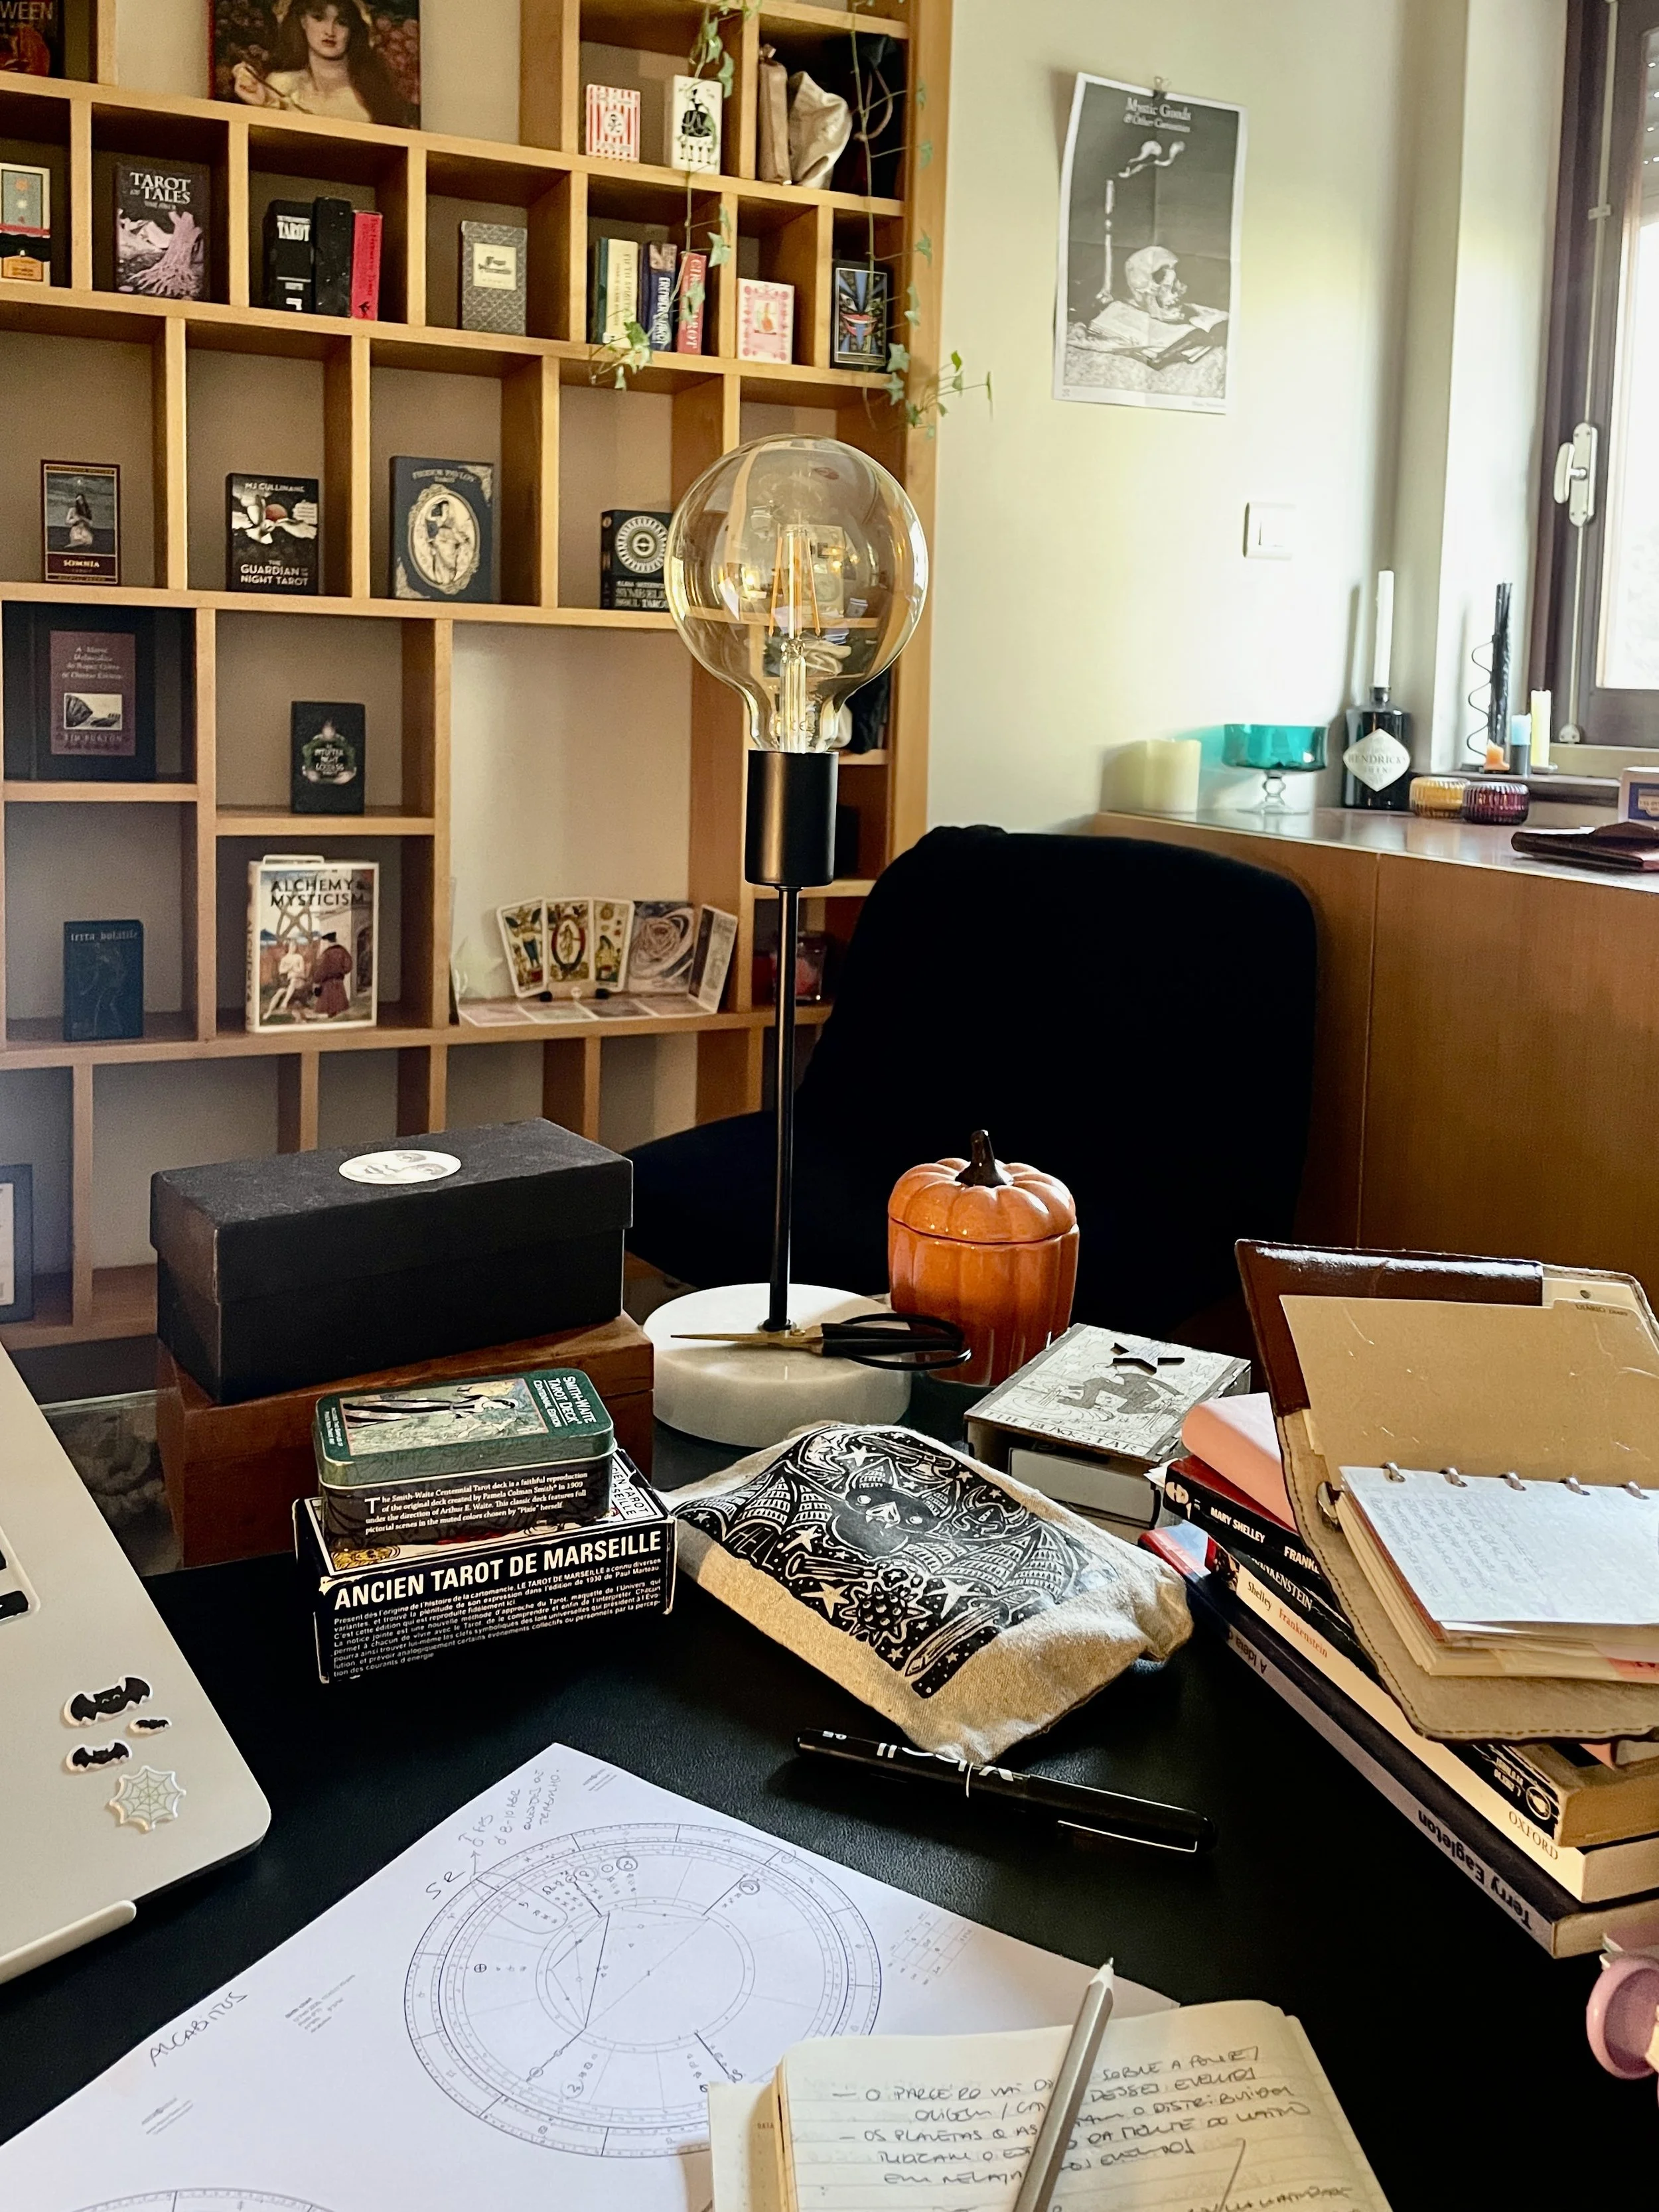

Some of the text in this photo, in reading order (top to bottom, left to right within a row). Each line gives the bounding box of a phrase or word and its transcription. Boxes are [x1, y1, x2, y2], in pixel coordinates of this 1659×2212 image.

[129, 172, 191, 191] TAROT
[145, 186, 190, 204] TALES
[277, 221, 311, 242] TAROT
[240, 564, 299, 576] GUARDIAN
[240, 575, 309, 586] NIGHT TAROT
[271, 878, 354, 892] ALCHEMY
[271, 894, 364, 907] MYSTICISM
[547, 1378, 568, 1401] TAROT
[563, 1376, 597, 1424] SMITH-WAITE
[391, 1491, 434, 1502] Smith-Waite
[435, 1485, 472, 1496] Centennial
[520, 1476, 545, 1486] faithful
[546, 1473, 587, 1483] reproduction
[612, 1467, 649, 1513] CIEN TAROT
[403, 1500, 429, 1510] original
[447, 1495, 472, 1504] created
[482, 1491, 506, 1499] Pamela
[365, 1523, 394, 1535] pictorial
[439, 1514, 461, 1523] muted
[1210, 1507, 1232, 1526] MARY
[1232, 1519, 1265, 1544] SHELLEY
[334, 1531, 661, 1610] ANCIEN TAROT DE MARSEILLE
[528, 1577, 551, 1587] TAROT
[483, 1592, 522, 1603] expression
[429, 1610, 466, 1621] reproduite
[1248, 1580, 1328, 1659] Shelley Frankenstein
[334, 1645, 360, 1655] permet
[371, 1638, 397, 1647] chacun
[507, 1608, 549, 1620] comprendre
[372, 1631, 393, 1641] jointe
[333, 1653, 358, 1663] pourra
[380, 1643, 406, 1652] trouver
[1236, 1636, 1267, 1674] A Ideia
[1509, 1811, 1558, 1860] OXFORD
[1418, 1810, 1532, 1931] Terry Eagleton
